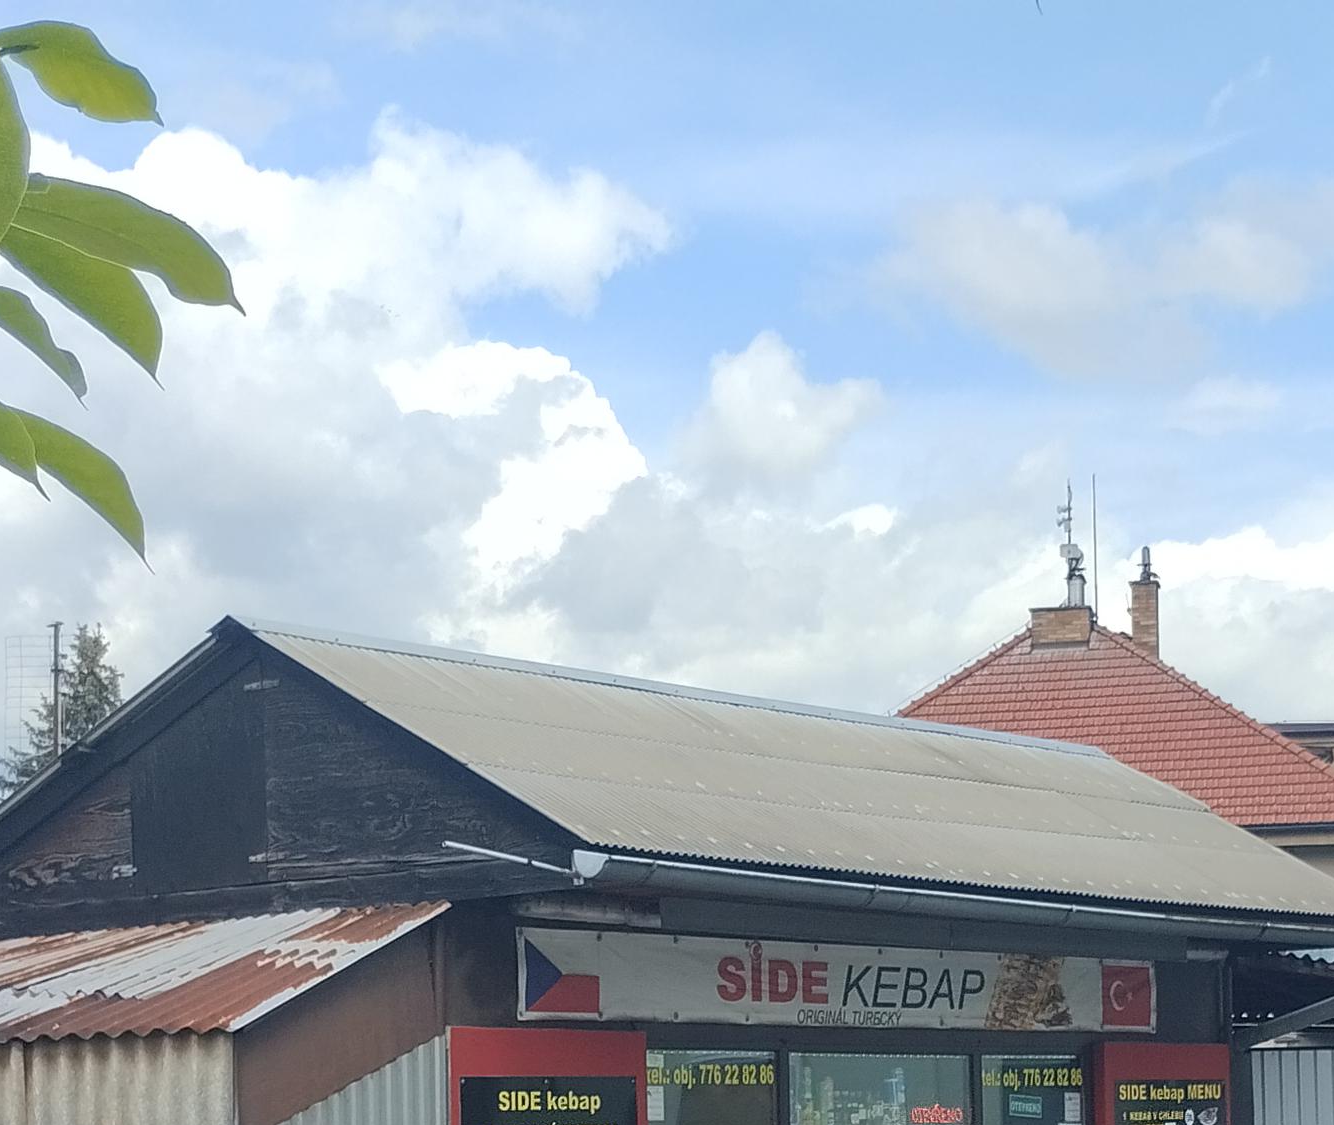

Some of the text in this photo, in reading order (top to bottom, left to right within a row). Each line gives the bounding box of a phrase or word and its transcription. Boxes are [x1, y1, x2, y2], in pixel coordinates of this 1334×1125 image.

[841, 964, 985, 1010] KEBAP
[852, 1009, 902, 1026] TURECKÝ
[699, 1064, 722, 1085] 776
[724, 1064, 739, 1085] 22
[742, 1064, 757, 1085] 82
[760, 1064, 775, 1085] 86
[1023, 1068, 1040, 1086] 776
[1042, 1068, 1055, 1086] 22
[1057, 1068, 1069, 1086] 82
[1070, 1068, 1083, 1086] 86
[498, 1090, 601, 1115] SIDE kebap
[1119, 1084, 1221, 1104] SIDE kebap MENU
